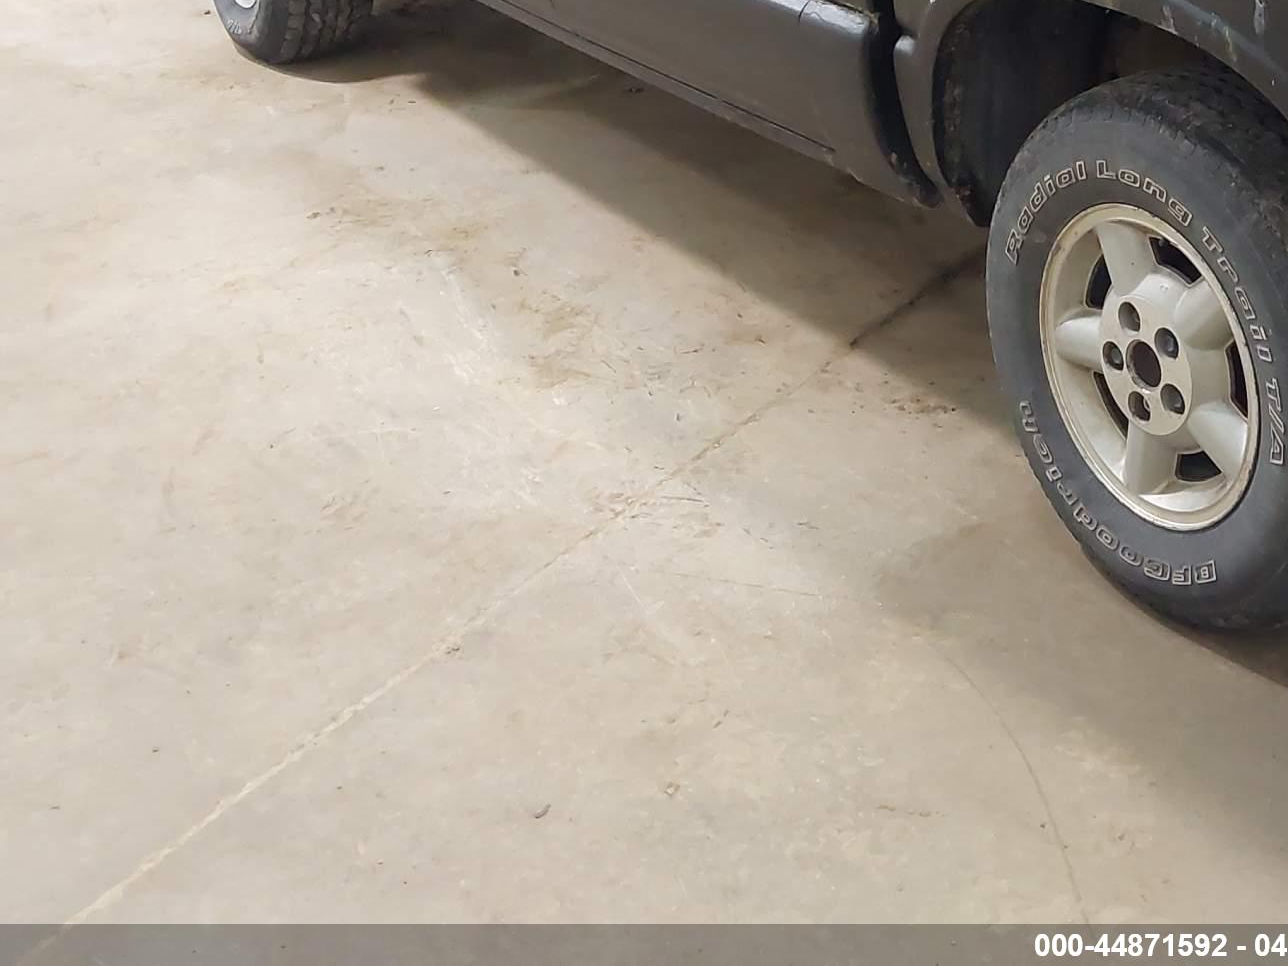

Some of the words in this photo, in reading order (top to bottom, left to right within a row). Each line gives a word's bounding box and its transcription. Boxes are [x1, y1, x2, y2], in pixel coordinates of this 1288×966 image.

[1005, 160, 1088, 265] Radial
[1096, 159, 1193, 227] Long
[1264, 377, 1286, 466] T/A
